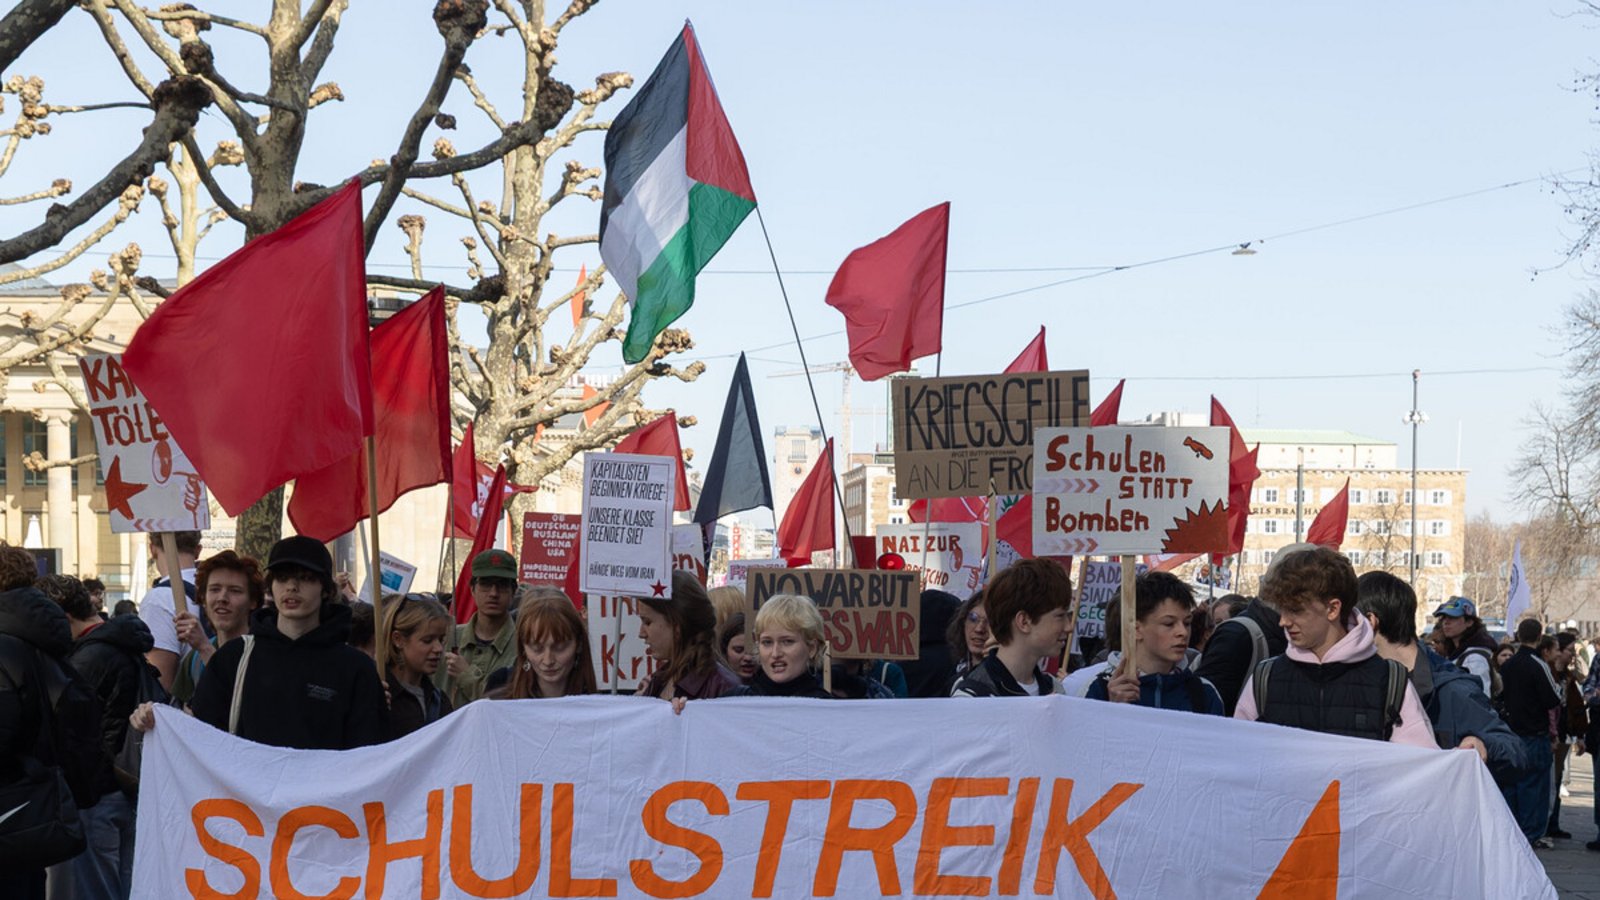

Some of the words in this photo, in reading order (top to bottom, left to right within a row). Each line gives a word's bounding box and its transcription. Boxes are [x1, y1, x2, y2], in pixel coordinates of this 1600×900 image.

[591, 461, 650, 481] KAPITALISTEN
[907, 463, 940, 494] AN
[948, 458, 979, 491] DIE
[590, 479, 633, 498] BEGINNEN
[1119, 475, 1193, 499] STATT
[588, 507, 621, 525] UNSERE
[622, 509, 655, 527] KLASSE
[1046, 496, 1149, 533] Bomben
[533, 530, 577, 539] RUSSLAN
[542, 540, 572, 548] CHINA
[588, 525, 626, 544] BEENDET
[626, 527, 644, 545] SIE!
[882, 535, 920, 553] NAI
[926, 535, 960, 552] ZUR
[547, 548, 565, 557] USA
[589, 561, 609, 577] HÄNDE
[610, 565, 625, 578] WEG
[624, 566, 640, 579] VOM
[639, 567, 655, 580] IRAN
[753, 572, 802, 610] NO
[804, 572, 864, 608] WAR
[868, 573, 914, 608] BUT
[852, 610, 916, 656] WAR
[186, 778, 1140, 900] SCHULSTREIK
